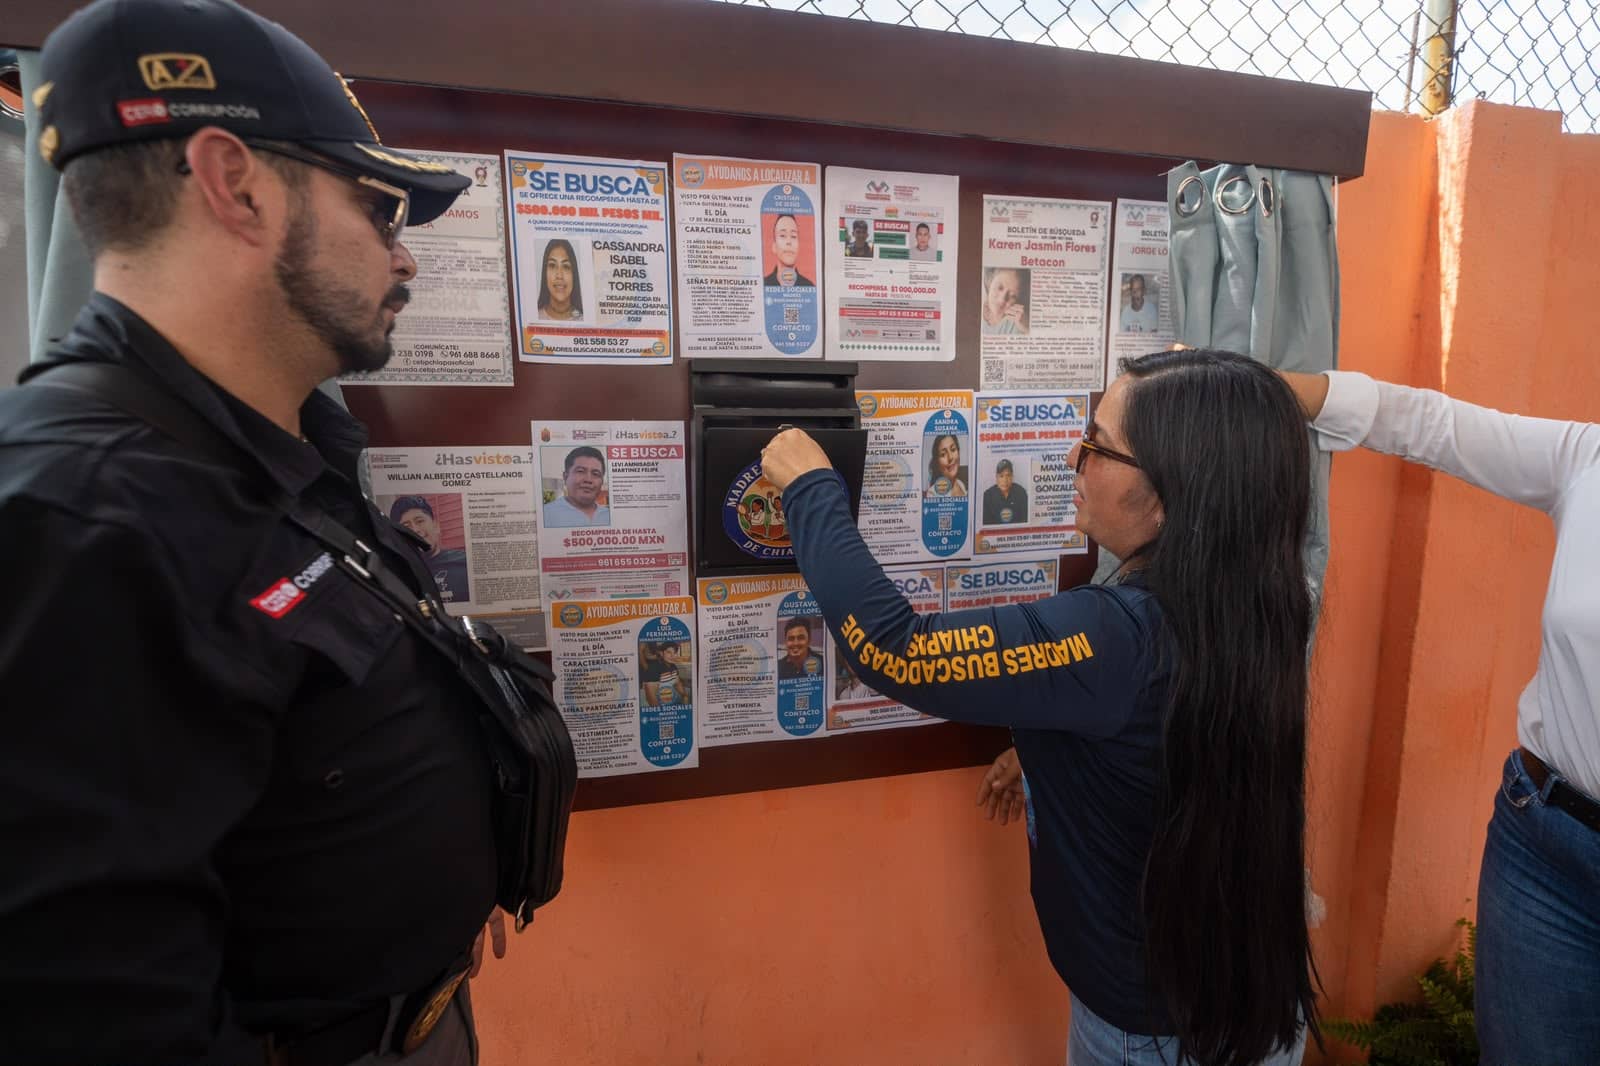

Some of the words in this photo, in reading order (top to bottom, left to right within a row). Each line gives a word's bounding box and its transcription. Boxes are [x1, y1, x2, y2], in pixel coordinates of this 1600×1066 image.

[753, 169, 759, 181] A
[760, 168, 803, 184] LOCALIZAR
[804, 170, 810, 184] A
[529, 170, 561, 192] SE
[564, 173, 650, 196] BUSCA
[529, 192, 558, 200] OFRECE
[602, 208, 639, 220] PESOS
[714, 208, 727, 216] DÍA
[684, 225, 752, 234] CARACTERÍSTICAS
[1049, 227, 1086, 236] BÚSQUEDA
[593, 241, 664, 252] CASSANDRA
[989, 238, 1021, 249] Karen
[1065, 242, 1096, 253] Flores
[610, 255, 647, 265] ISABEL
[1021, 256, 1065, 267] Betacon
[613, 269, 647, 279] ARIAS
[686, 277, 708, 285] SEÑAS
[608, 282, 653, 292] TORRES
[919, 398, 925, 408] A
[925, 396, 960, 408] LOCALIZAR
[962, 396, 967, 408] A
[990, 406, 1012, 421] SE
[1015, 404, 1075, 420] BUSCA
[612, 448, 628, 458] SE
[631, 448, 678, 457] BUSCA
[571, 529, 621, 537] RECOMPENSA
[563, 536, 637, 548] $500,000.00
[639, 536, 665, 544] MXN
[743, 541, 760, 553] DE
[961, 574, 983, 590] SE
[985, 569, 1046, 587] BUSCA
[771, 581, 777, 590] A
[631, 607, 638, 615] A
[639, 603, 680, 615] LOCALIZAR
[682, 602, 687, 613] A
[737, 618, 749, 626] DÍA
[840, 613, 866, 650] DE
[709, 631, 769, 643] CARACTERÍSTICAS
[592, 642, 605, 650] DÍA
[1002, 631, 1095, 675] MADRES
[563, 657, 628, 667] CARACTERÍSTICAS
[858, 640, 1001, 685] BUSCADORAS
[586, 703, 634, 711] PARTICULARES
[784, 709, 820, 717] CONTACTO
[578, 729, 618, 737] VESTIMENTA
[648, 738, 686, 747] CONTACTO
